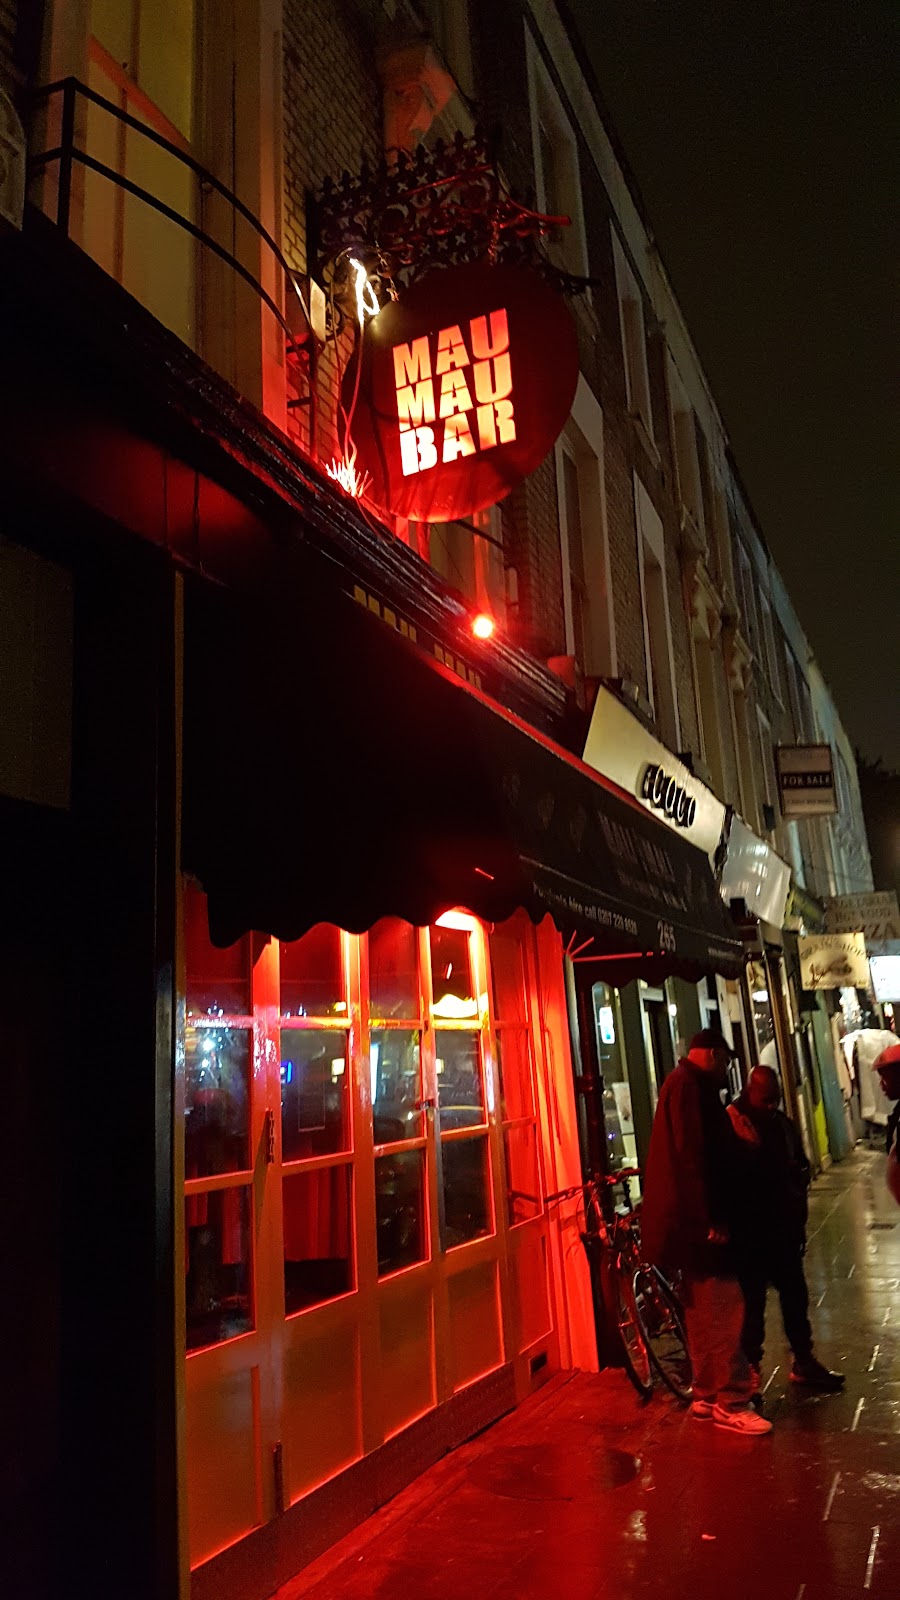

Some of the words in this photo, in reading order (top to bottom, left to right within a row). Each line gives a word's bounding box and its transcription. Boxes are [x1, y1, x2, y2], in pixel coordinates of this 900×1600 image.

[392, 308, 510, 388] MAU
[396, 352, 513, 432] MAU
[400, 399, 516, 476] BAR
[783, 775, 803, 786] FOR
[807, 774, 830, 785] SALE
[584, 904, 597, 920] call
[657, 920, 676, 952] 265
